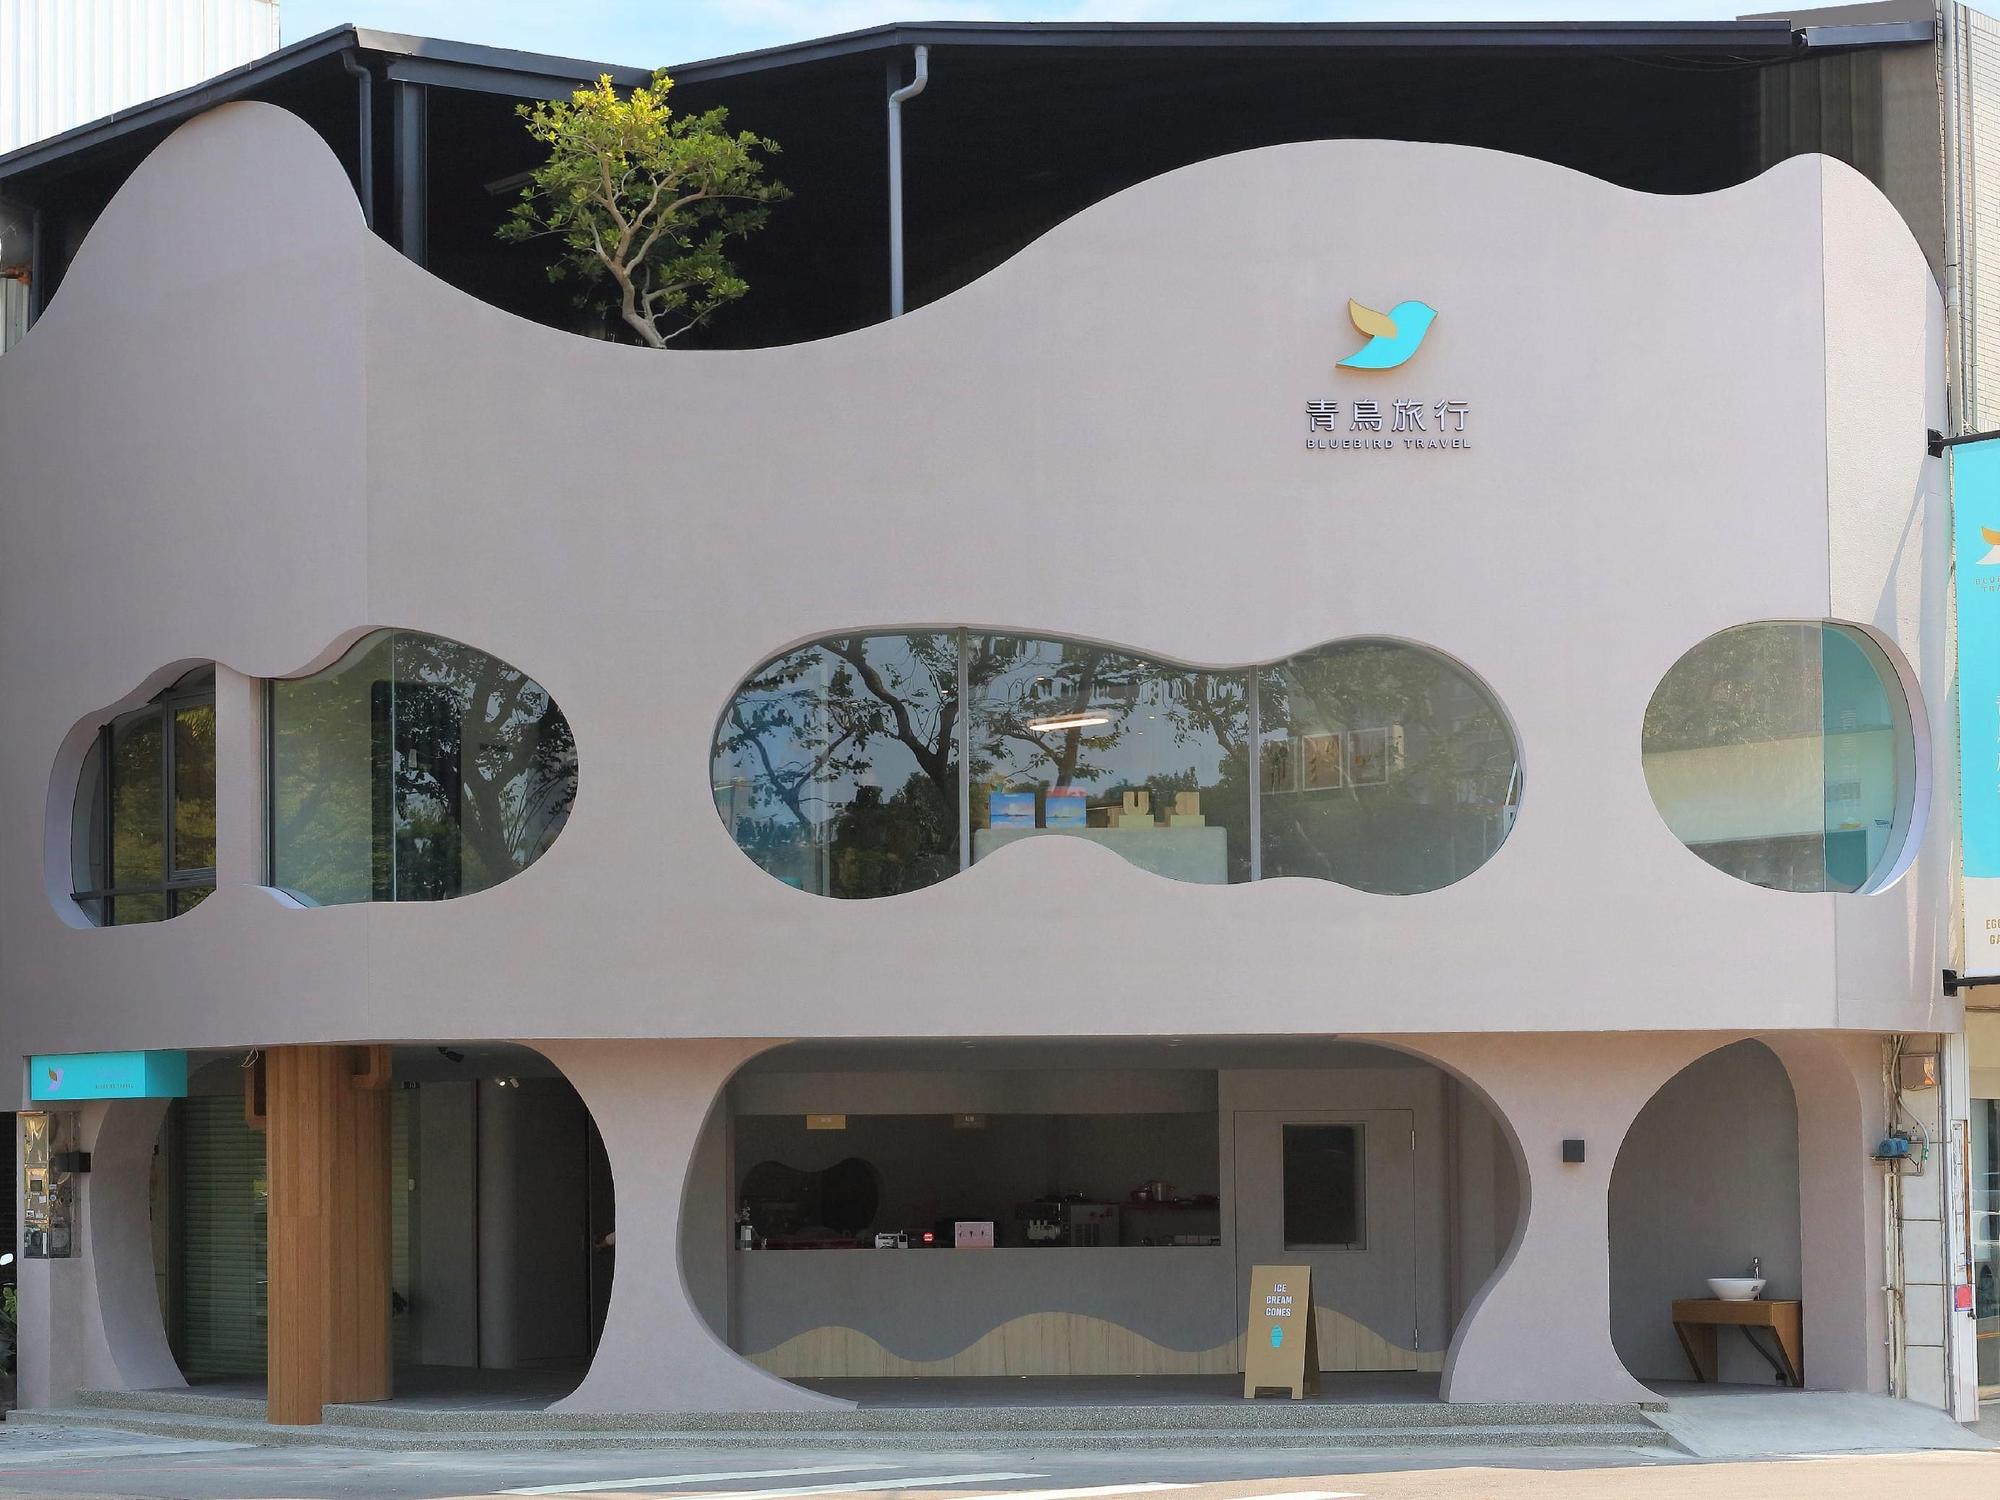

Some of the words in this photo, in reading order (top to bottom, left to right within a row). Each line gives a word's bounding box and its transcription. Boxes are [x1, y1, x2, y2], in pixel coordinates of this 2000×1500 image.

[1306, 399, 1470, 432] 青鳥旅行
[1306, 439, 1394, 449] BLUEBIRD
[1404, 439, 1471, 449] TRAVEL
[1273, 1283, 1287, 1293] ICE
[1266, 1295, 1292, 1305] CREAM
[1265, 1307, 1291, 1317] CONES
